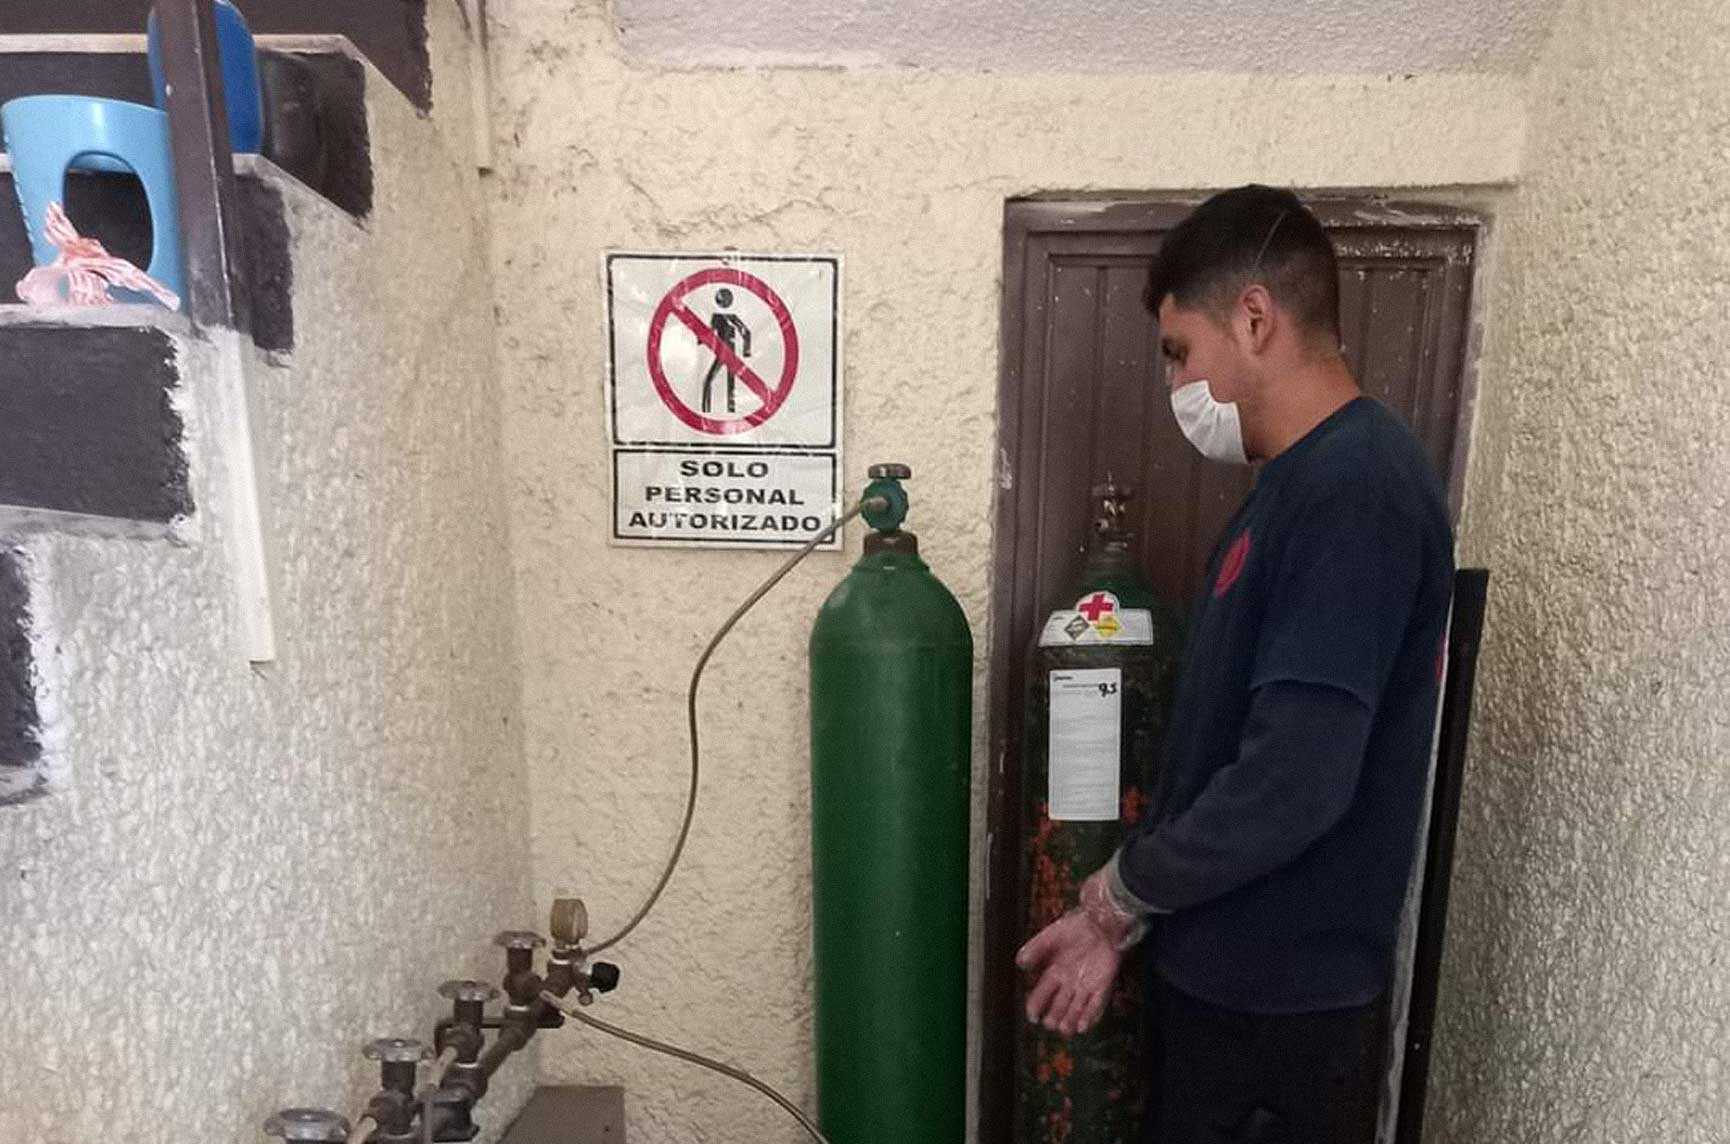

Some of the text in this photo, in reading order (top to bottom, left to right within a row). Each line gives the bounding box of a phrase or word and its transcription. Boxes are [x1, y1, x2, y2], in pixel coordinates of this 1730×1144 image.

[680, 460, 769, 478] SOLO
[645, 486, 805, 505] PERSONAL
[628, 512, 822, 532] AUTORIZADO
